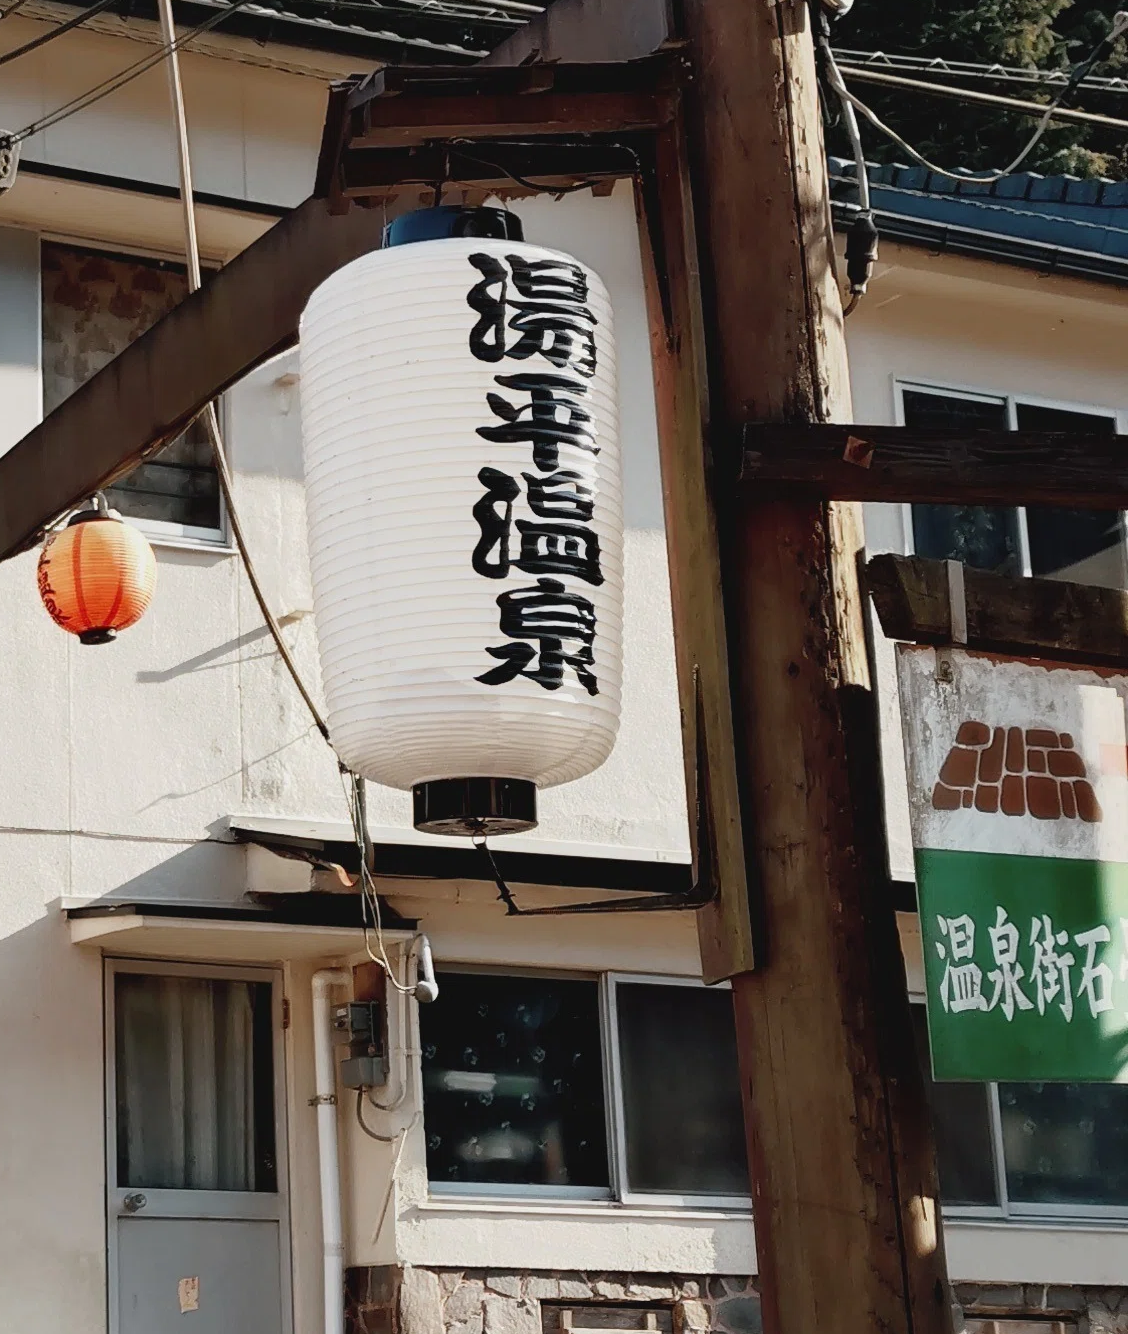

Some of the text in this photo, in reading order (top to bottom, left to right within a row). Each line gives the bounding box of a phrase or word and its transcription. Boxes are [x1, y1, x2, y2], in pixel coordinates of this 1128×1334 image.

[467, 253, 604, 695] 湯平温泉
[936, 906, 1128, 1023] 温泉街石
